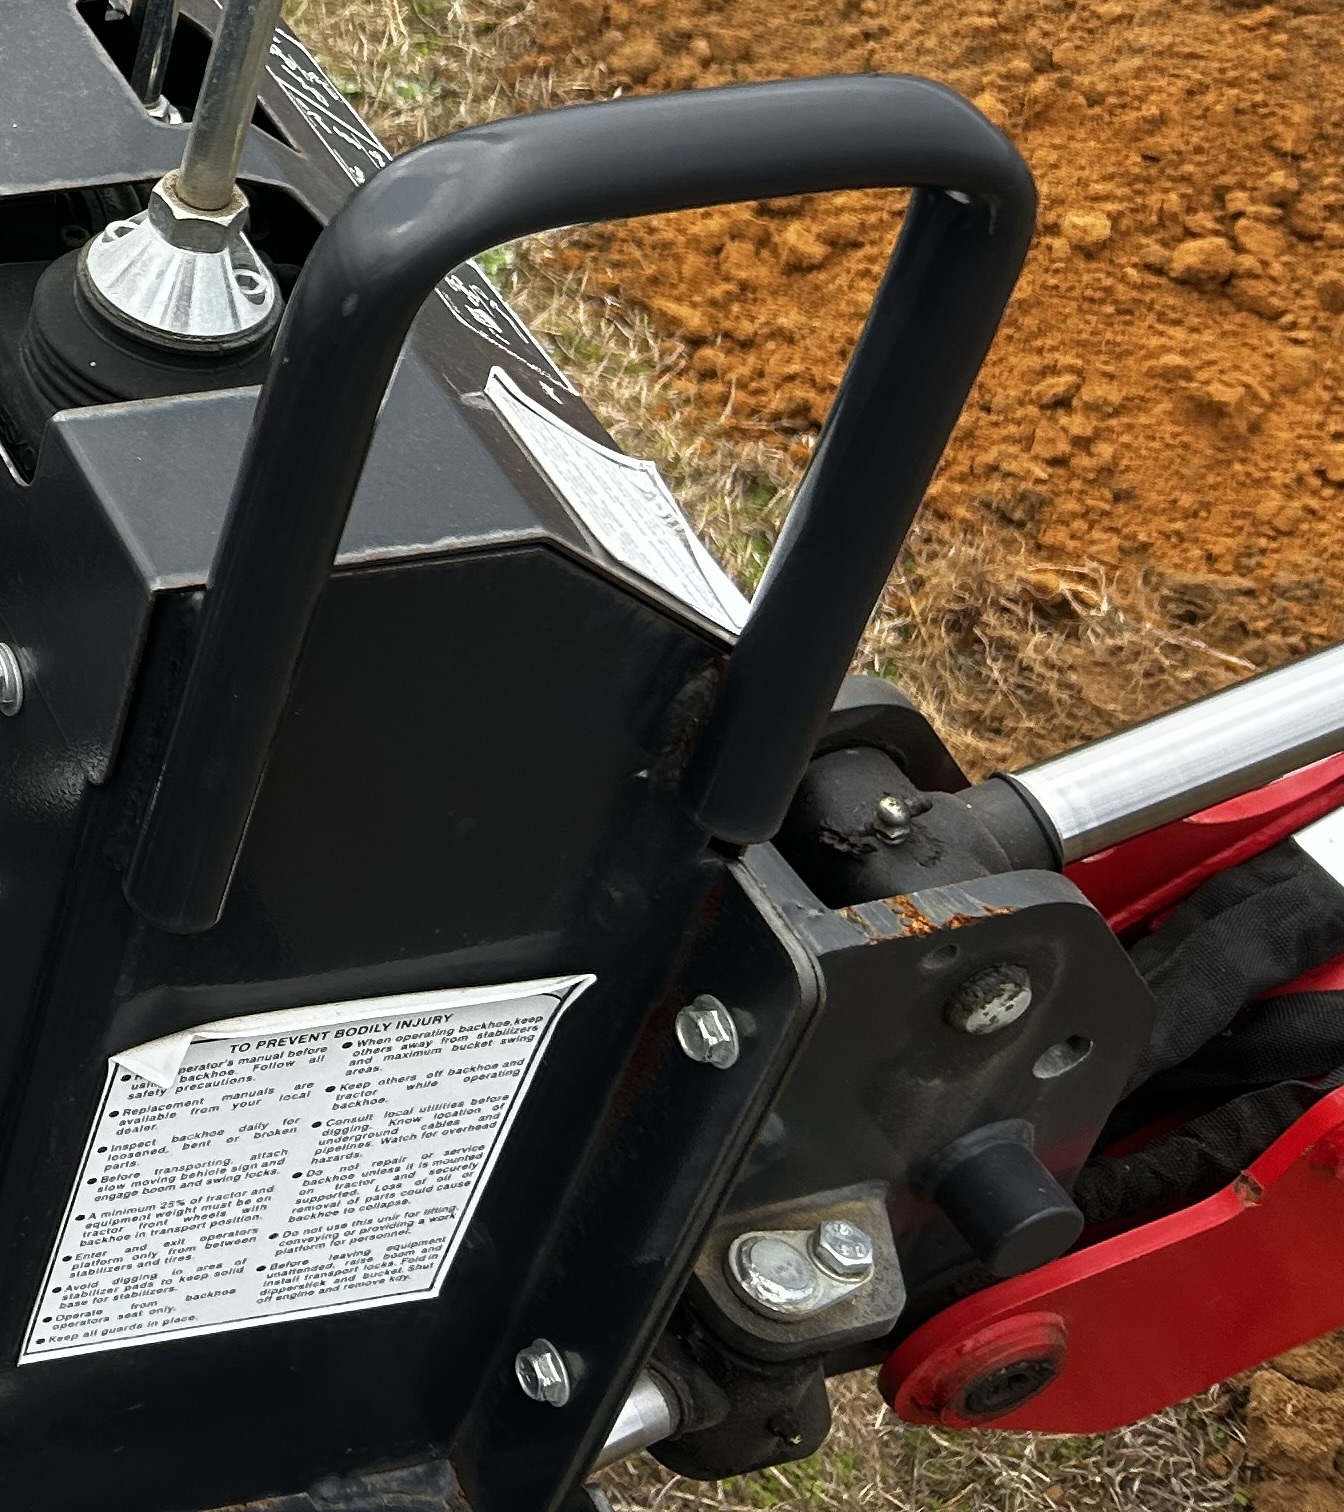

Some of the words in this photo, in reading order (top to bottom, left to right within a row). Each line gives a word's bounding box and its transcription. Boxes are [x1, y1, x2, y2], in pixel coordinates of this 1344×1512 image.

[229, 1042, 251, 1053] TO
[255, 1030, 331, 1050] PREVENT
[333, 1021, 392, 1038] BODILY
[395, 1013, 453, 1029] INJURY
[351, 1045, 392, 1057] others
[400, 1040, 433, 1050] away
[440, 1034, 468, 1044] from
[476, 1024, 538, 1039] stabilizers
[357, 1037, 391, 1047] When
[394, 1028, 455, 1042] operating
[177, 1059, 233, 1076] perator's
[237, 1050, 284, 1064] manual
[287, 1046, 327, 1057] before
[251, 1060, 295, 1072] Follow
[308, 1054, 325, 1063] all
[348, 1056, 373, 1066] and
[382, 1047, 442, 1061] maximum
[450, 1039, 493, 1051] bucket
[335, 1089, 378, 1101] tractor
[406, 1080, 438, 1090] while
[462, 1068, 520, 1083] operating
[339, 1081, 371, 1091] Keep
[377, 1074, 416, 1085] others
[425, 1069, 444, 1078] off
[446, 1063, 498, 1076] backhoe
[501, 1057, 525, 1068] and
[118, 1111, 176, 1126] available
[189, 1105, 219, 1115] from
[231, 1098, 262, 1110] your
[278, 1089, 311, 1101] local
[121, 1097, 204, 1116] Replacement
[221, 1086, 274, 1101] manuals
[293, 1082, 314, 1090] are
[127, 1088, 167, 1100] safety
[325, 1113, 373, 1127] Consult
[383, 1106, 414, 1118] local
[418, 1100, 464, 1113] utilities
[387, 1116, 422, 1126] Know
[433, 1107, 481, 1119] location
[110, 1138, 156, 1152] Inspect
[170, 1129, 224, 1143] backhoe
[238, 1121, 269, 1132] daily
[282, 1117, 300, 1125] for
[181, 1139, 211, 1150] bent
[225, 1135, 240, 1143] or
[253, 1126, 297, 1139] broken
[317, 1126, 399, 1145] underground
[420, 1119, 460, 1130] cables
[477, 1111, 500, 1121] and
[380, 1133, 417, 1144] Watch
[420, 1130, 438, 1139] for
[441, 1120, 497, 1135] overhead
[96, 1183, 125, 1192] slow
[130, 1175, 176, 1187] moving
[230, 1162, 258, 1172] sign
[260, 1156, 285, 1167] and
[100, 1172, 140, 1183] Before
[249, 1148, 288, 1160] attach
[301, 1173, 355, 1186] backhoe
[360, 1165, 401, 1177] unless
[305, 1169, 323, 1177] Do
[338, 1162, 359, 1172] not
[371, 1155, 407, 1167] repair
[87, 1212, 96, 1220] A
[100, 1204, 156, 1218] minimum
[189, 1195, 203, 1204] of
[205, 1190, 248, 1202] tractor
[250, 1184, 275, 1195] and
[93, 1190, 138, 1202] engage
[141, 1184, 176, 1194] boom
[179, 1178, 203, 1188] and
[82, 1226, 124, 1238] tractor
[138, 1218, 168, 1229] front
[183, 1210, 226, 1222] wheels
[84, 1212, 151, 1229] equipment
[155, 1205, 197, 1218] weight
[200, 1200, 232, 1211] must
[235, 1198, 251, 1206] be
[255, 1195, 271, 1203] on
[282, 1230, 299, 1238] Do
[302, 1225, 323, 1235] not
[325, 1222, 347, 1231] use
[351, 1218, 373, 1227] this
[403, 1210, 420, 1218] for
[74, 1250, 107, 1260] Enter
[124, 1243, 147, 1253] and
[162, 1237, 185, 1247] exit
[199, 1227, 258, 1242] operators
[79, 1234, 131, 1247] backhoe
[150, 1221, 206, 1236] transport
[69, 1263, 132, 1278] stabilizers
[136, 1257, 160, 1268] and
[70, 1256, 123, 1271] platform
[131, 1250, 158, 1260] only
[167, 1245, 196, 1255] from
[204, 1236, 256, 1249] between
[63, 1280, 99, 1292] Avoid
[111, 1272, 157, 1285] digging
[55, 1309, 103, 1322] Operate
[48, 1333, 79, 1343] Keep
[82, 1328, 97, 1337] all
